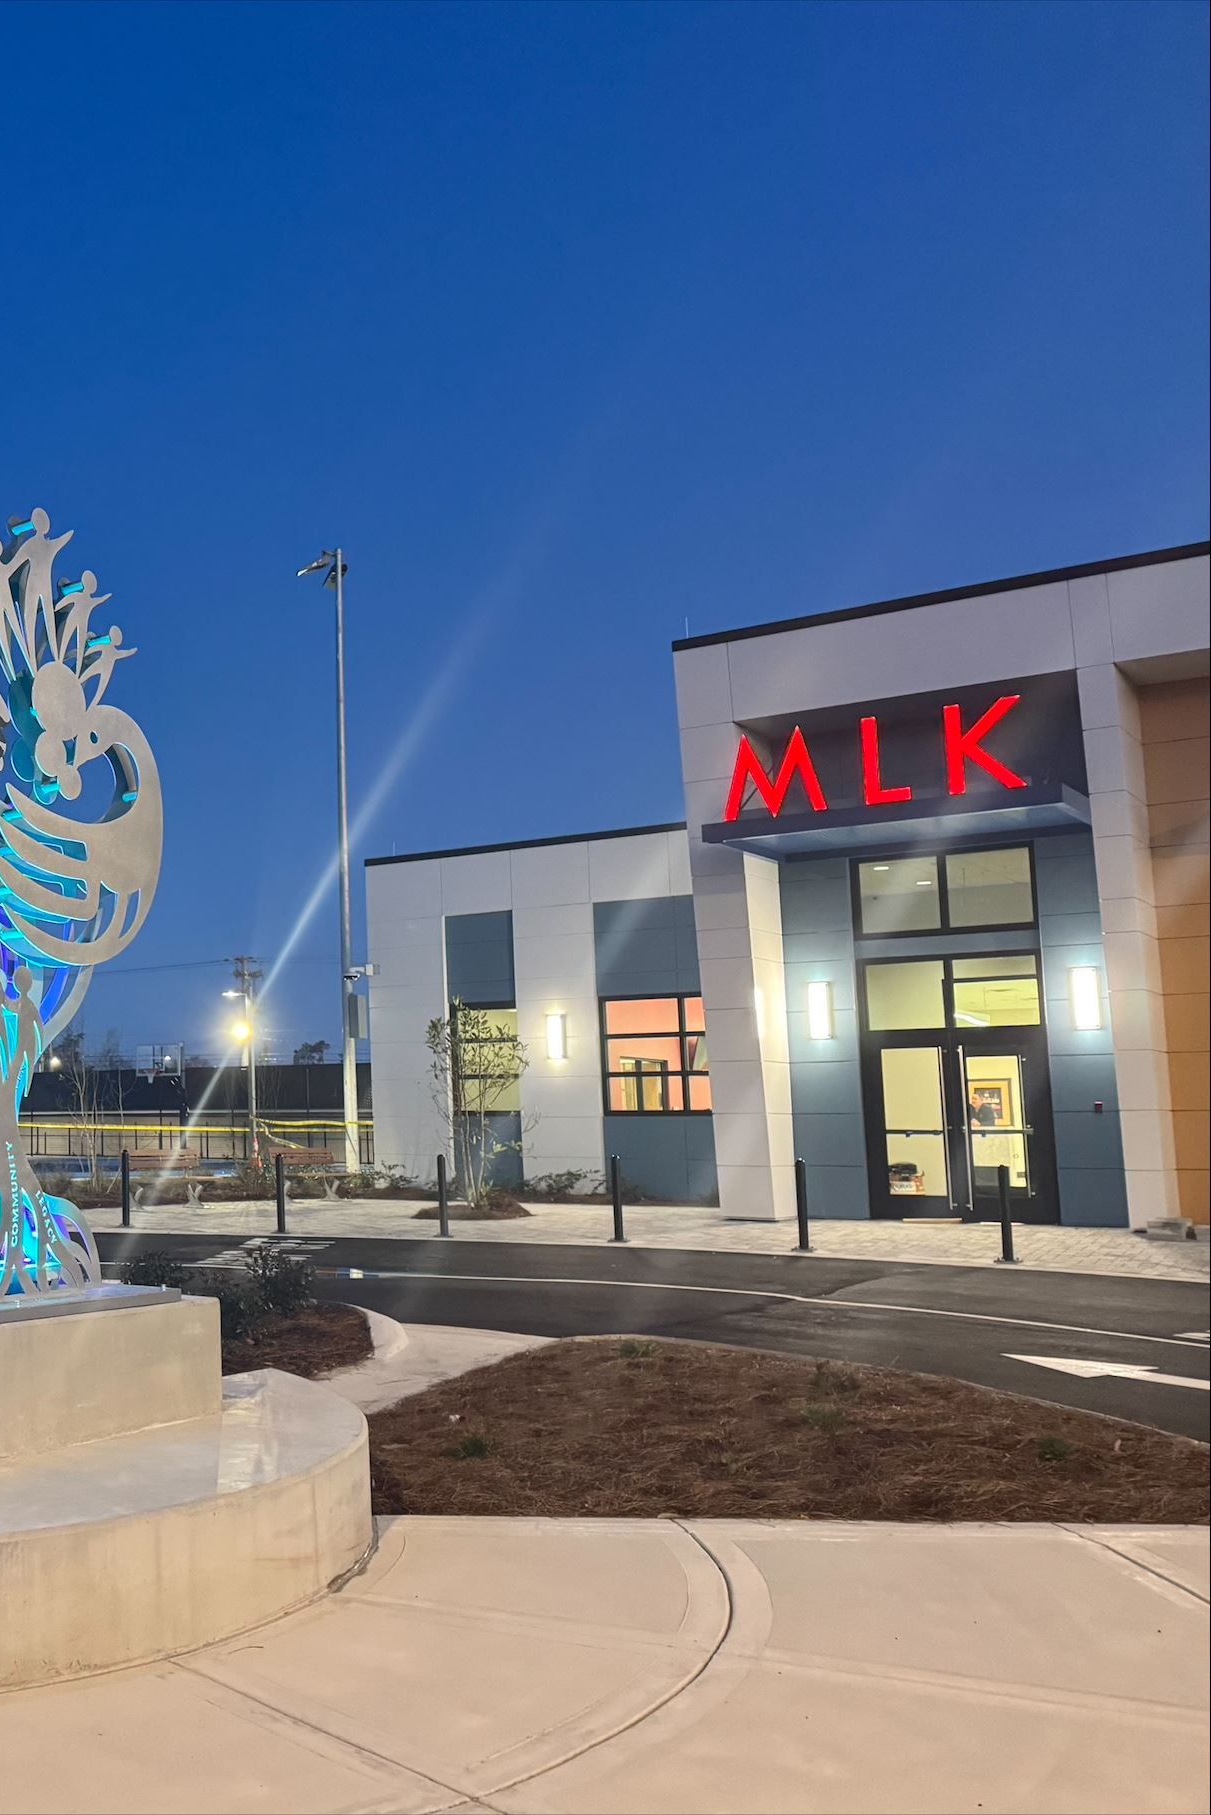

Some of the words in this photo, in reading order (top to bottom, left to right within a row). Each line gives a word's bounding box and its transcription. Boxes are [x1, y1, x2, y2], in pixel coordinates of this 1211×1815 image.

[723, 694, 1029, 822] MLK
[5, 1140, 19, 1248] COMMUNITY
[35, 1190, 58, 1244] LEGACY
